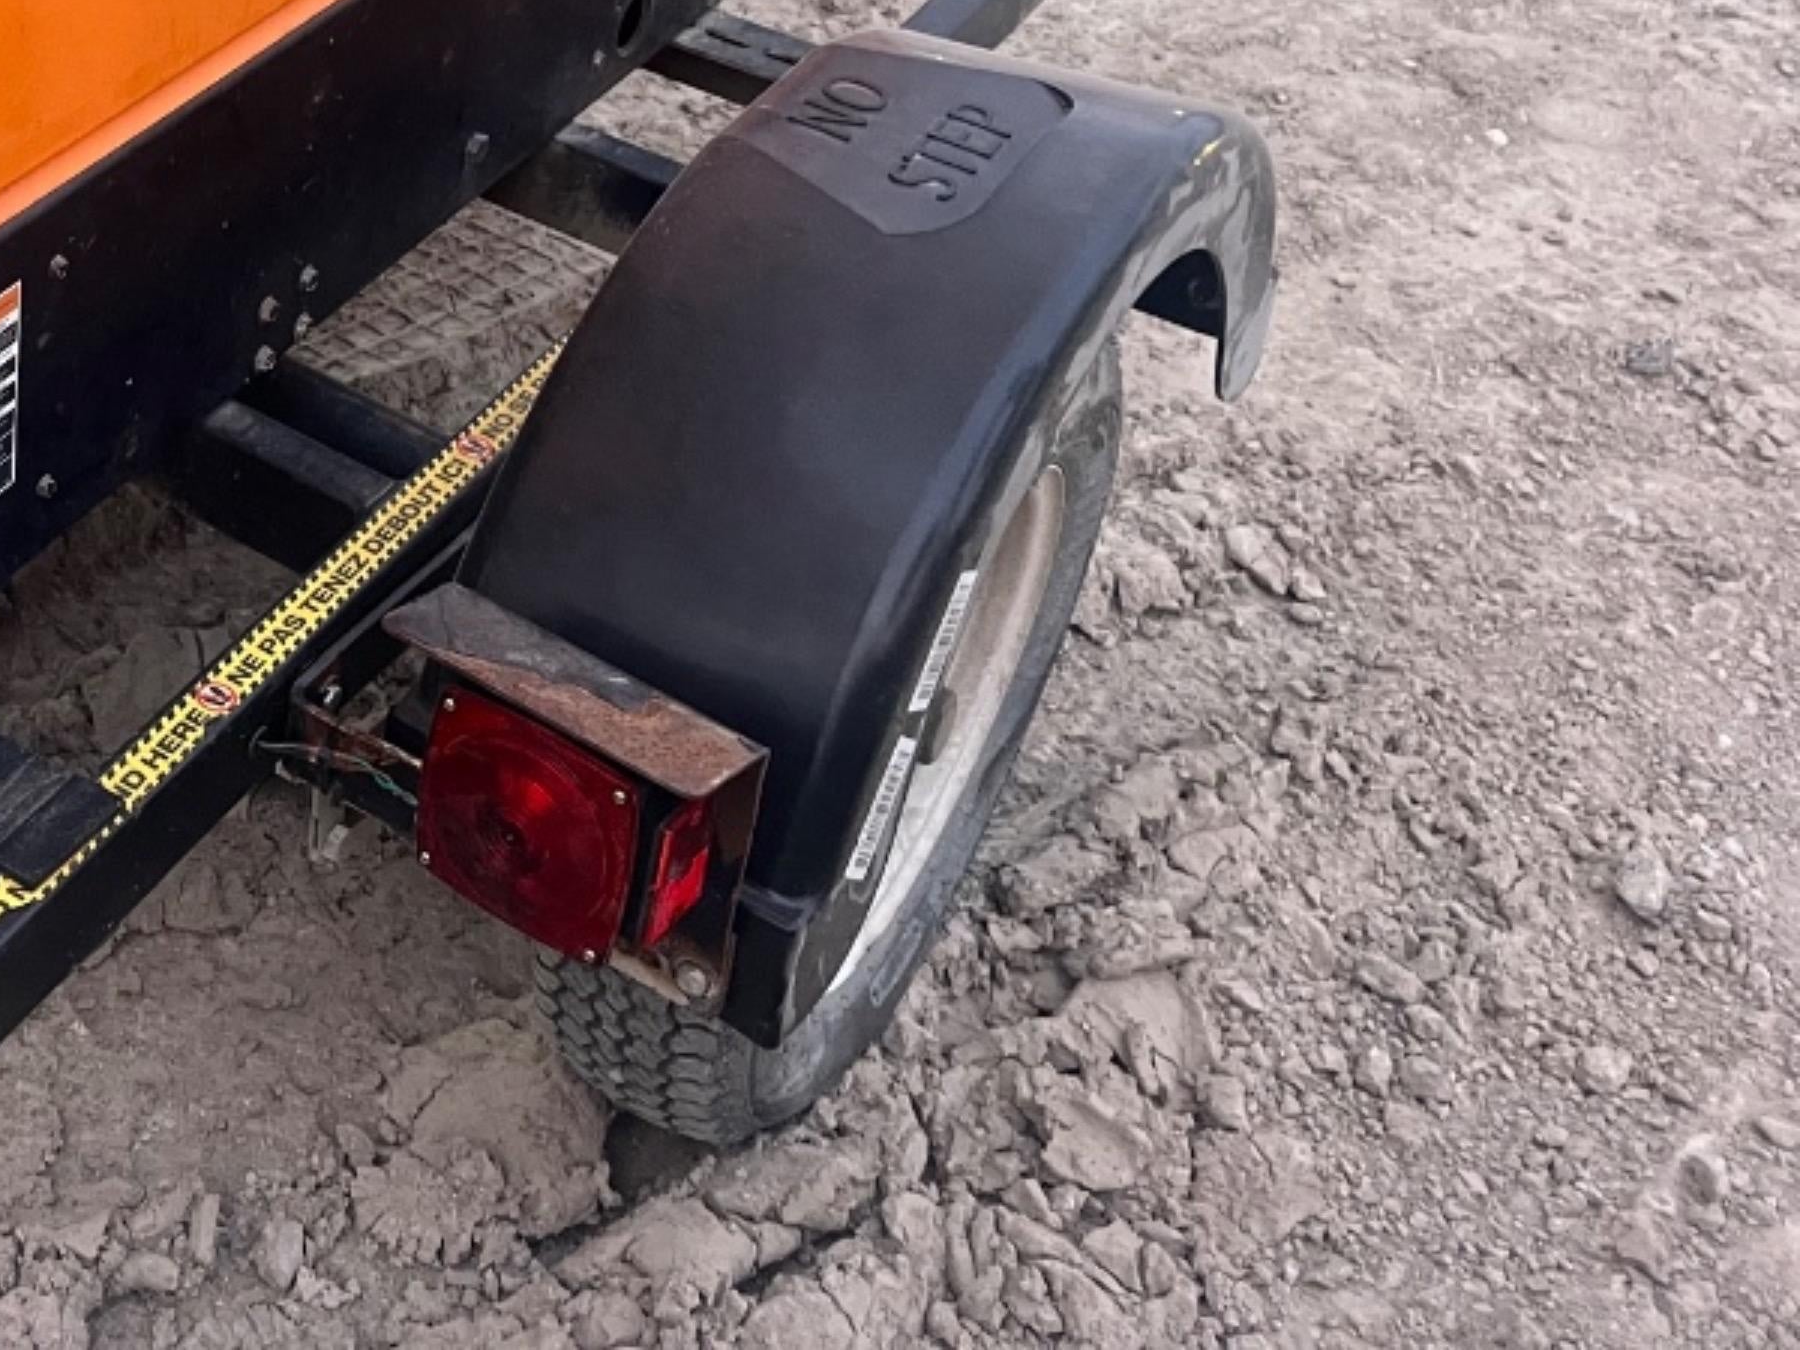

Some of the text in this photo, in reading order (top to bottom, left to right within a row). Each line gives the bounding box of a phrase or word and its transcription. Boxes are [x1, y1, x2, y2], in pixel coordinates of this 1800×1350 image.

[785, 75, 890, 144] NO
[887, 103, 1013, 202] STEP
[227, 459, 469, 688] NE PAS TENEZ DEBOUT ICI
